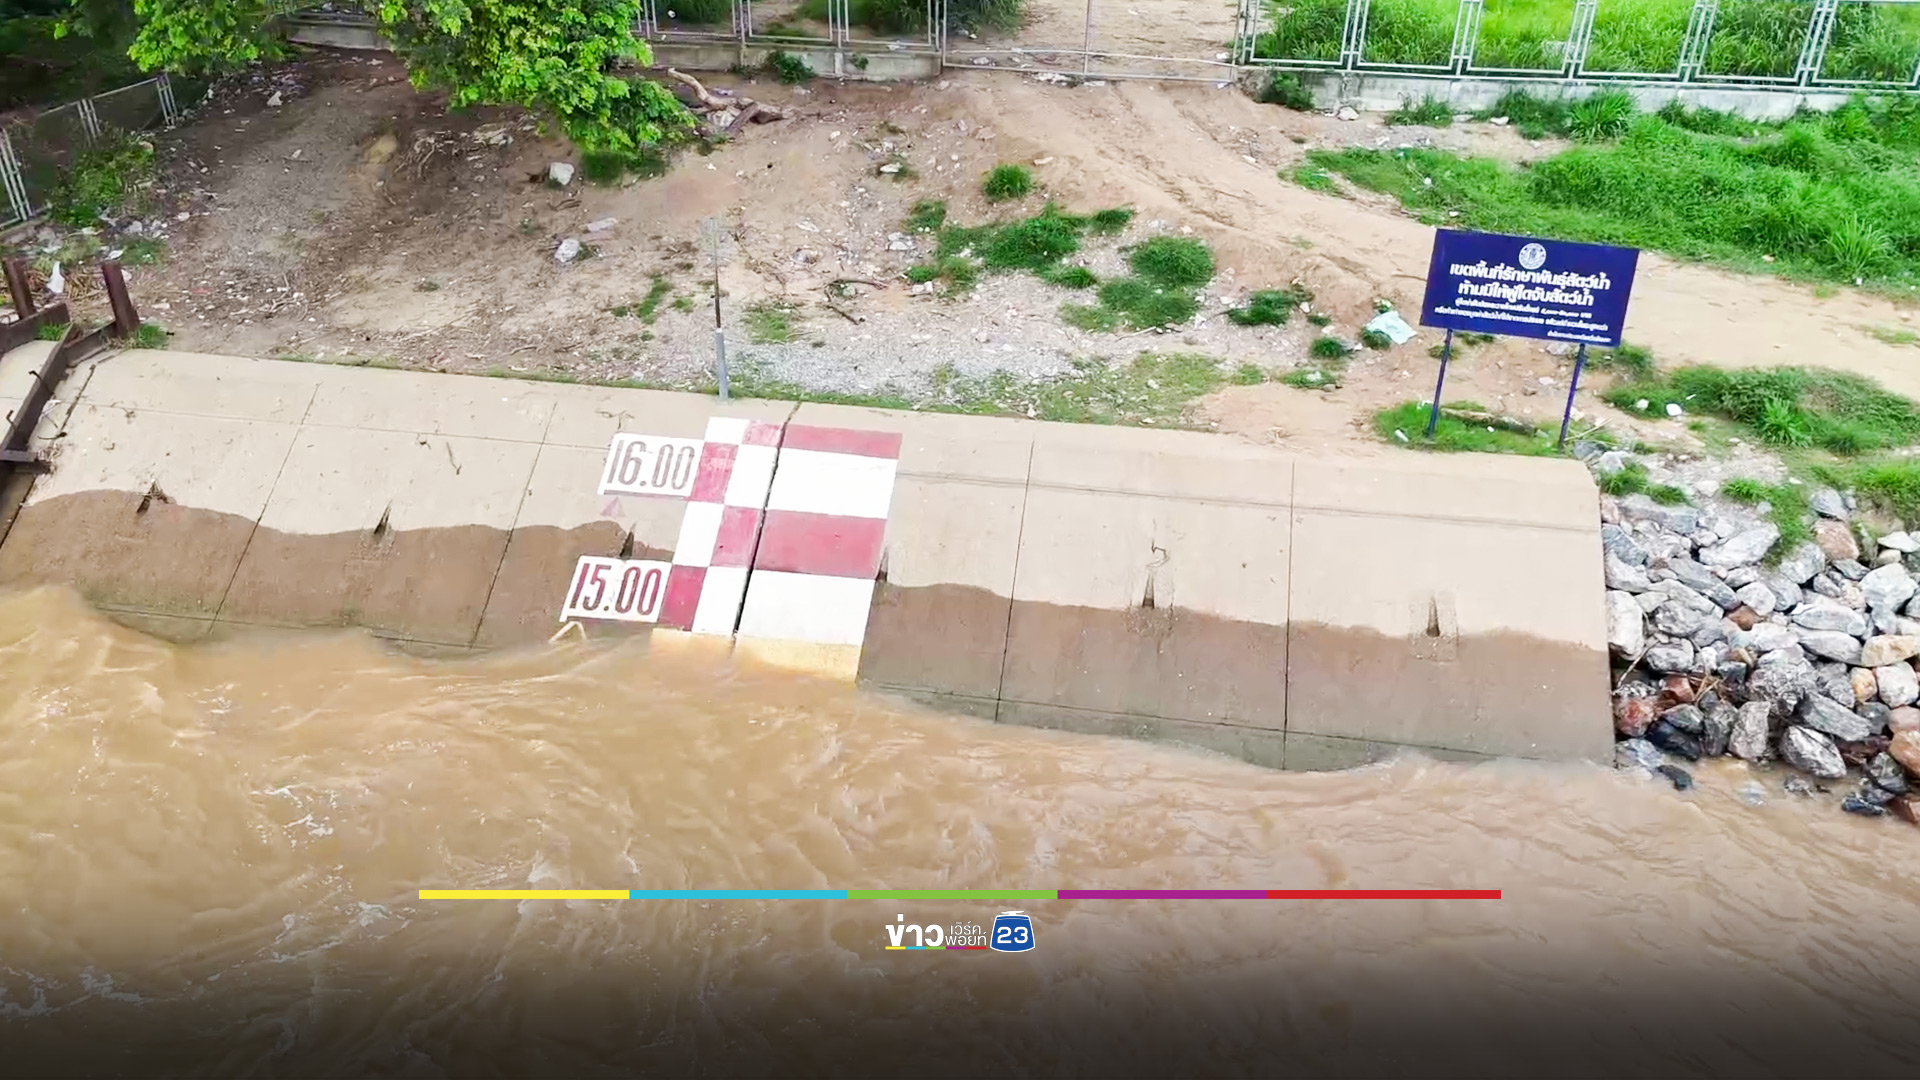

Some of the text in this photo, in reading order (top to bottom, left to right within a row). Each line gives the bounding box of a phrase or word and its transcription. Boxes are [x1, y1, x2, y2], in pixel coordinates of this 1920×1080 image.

[1450, 260, 1611, 290] เขตพื้นที่รักษาพันธุ์สัตว์น้ำ
[1458, 279, 1594, 306] ห้ามมิให้ผู้ใดจับสัตว์น้ำ
[607, 440, 695, 490] 16.00
[569, 563, 662, 615] 15.00
